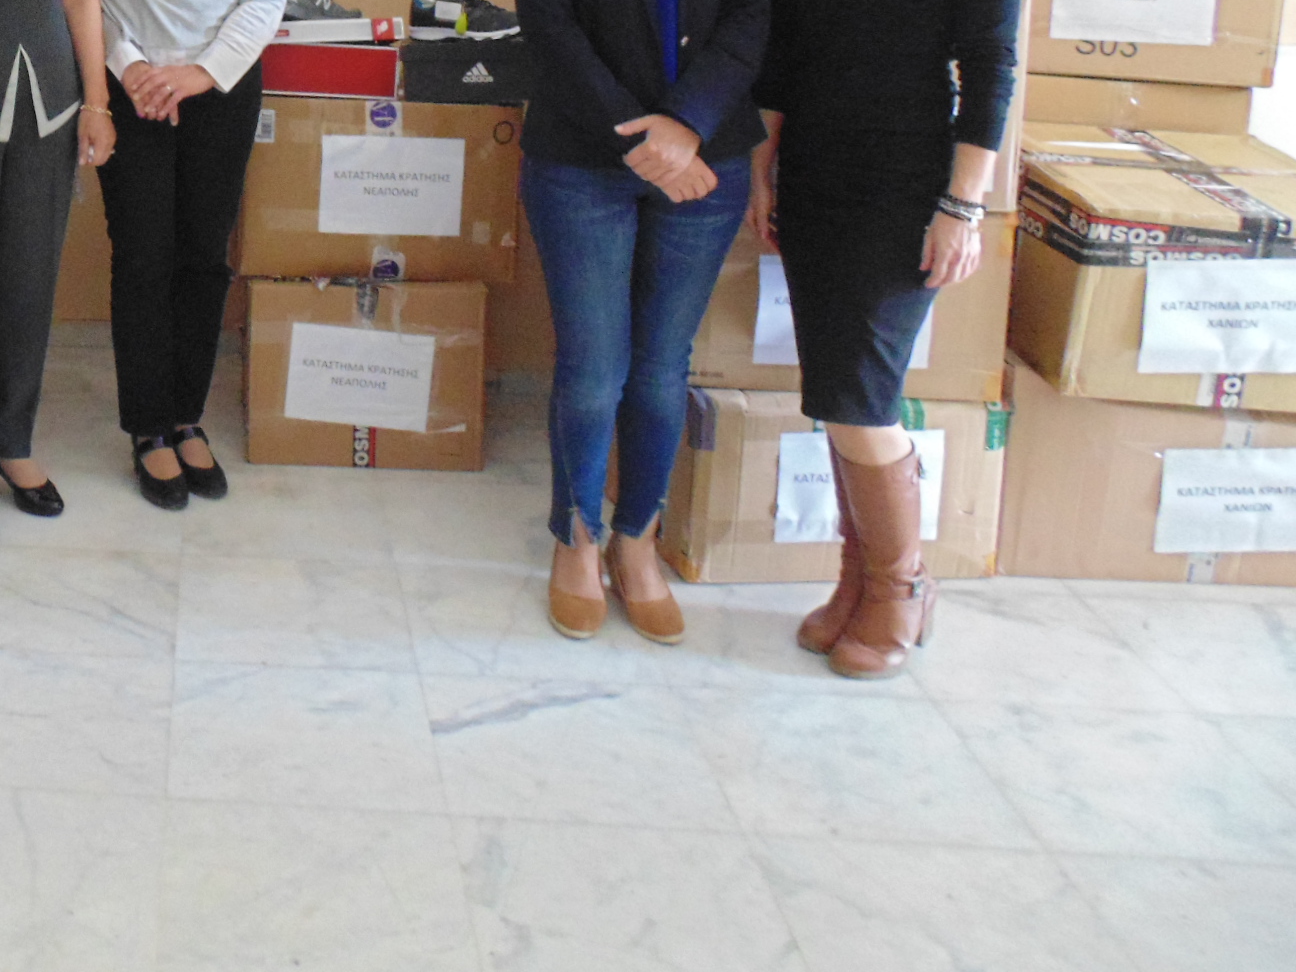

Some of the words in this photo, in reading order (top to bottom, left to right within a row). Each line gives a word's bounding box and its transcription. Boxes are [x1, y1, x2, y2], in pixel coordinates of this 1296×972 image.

[333, 171, 397, 181] ΚΑΤΑΣΤΗΜΑ
[399, 173, 451, 183] ΚΡΑΤΗΣΗΣ
[363, 187, 420, 197] ΝΕΑΠΟΛΗΣ
[1160, 300, 1241, 311] ΚΑΤΑΣΤΗΜΑ
[1207, 319, 1259, 329] ΧΑΝΙΩΝ
[302, 359, 365, 372] ΚΑΤΑΣΤΗΜΑ
[367, 365, 420, 379] ΚΡΑΤΗΣΗΣ
[331, 377, 387, 390] ΝΕΑΠΟΛΗΣ
[1177, 486, 1255, 497] ΚΑΤΑΣΤΗΜΑ
[1224, 503, 1273, 513] ΧΑΝΙΩΝ
